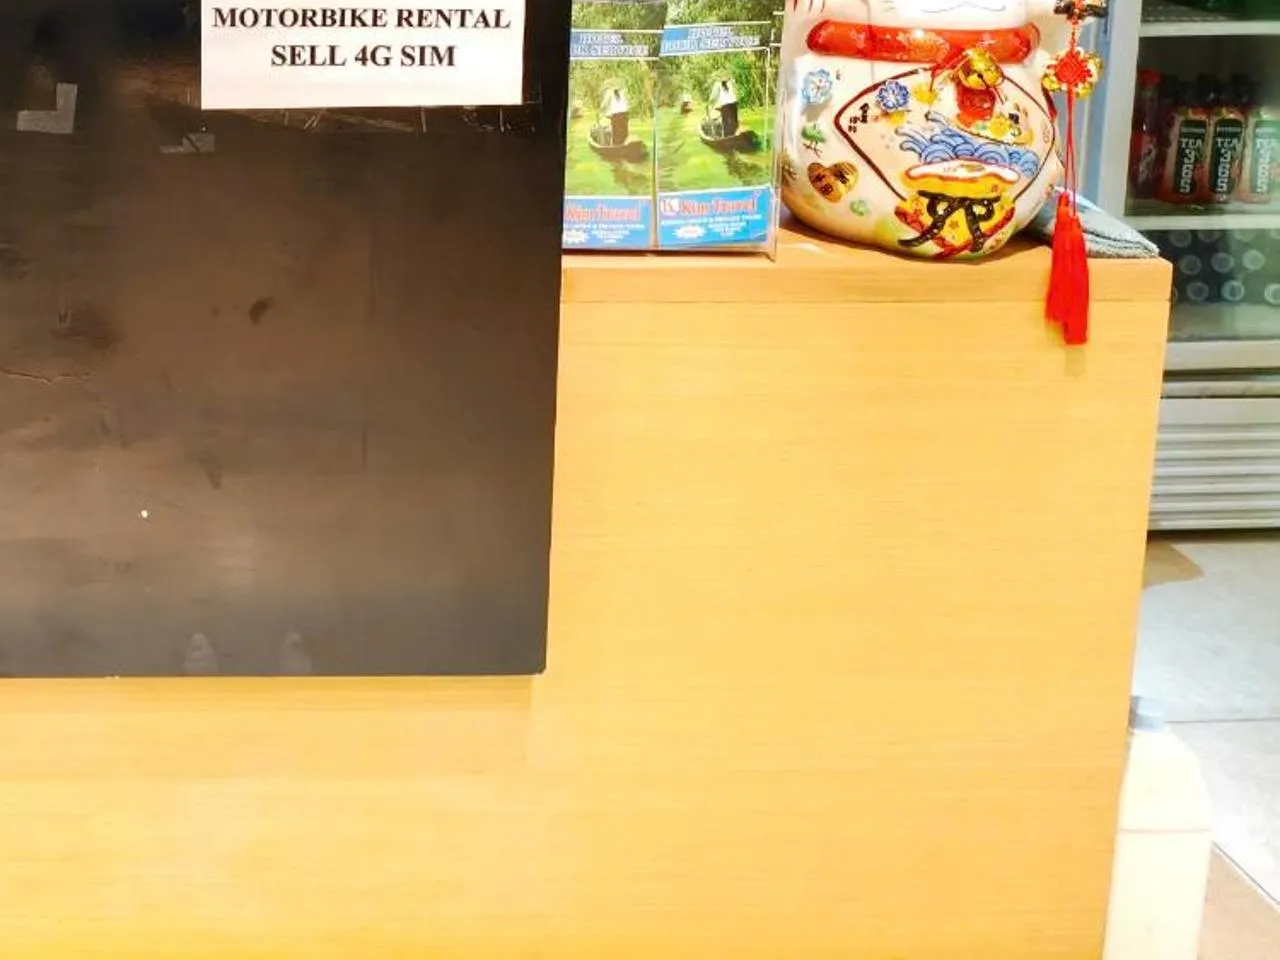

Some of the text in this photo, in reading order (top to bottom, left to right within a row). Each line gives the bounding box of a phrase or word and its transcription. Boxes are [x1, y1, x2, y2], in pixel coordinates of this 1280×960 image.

[213, 8, 511, 29] MOTORBIKE RENTAL
[271, 45, 456, 67] SELL 4G SIM
